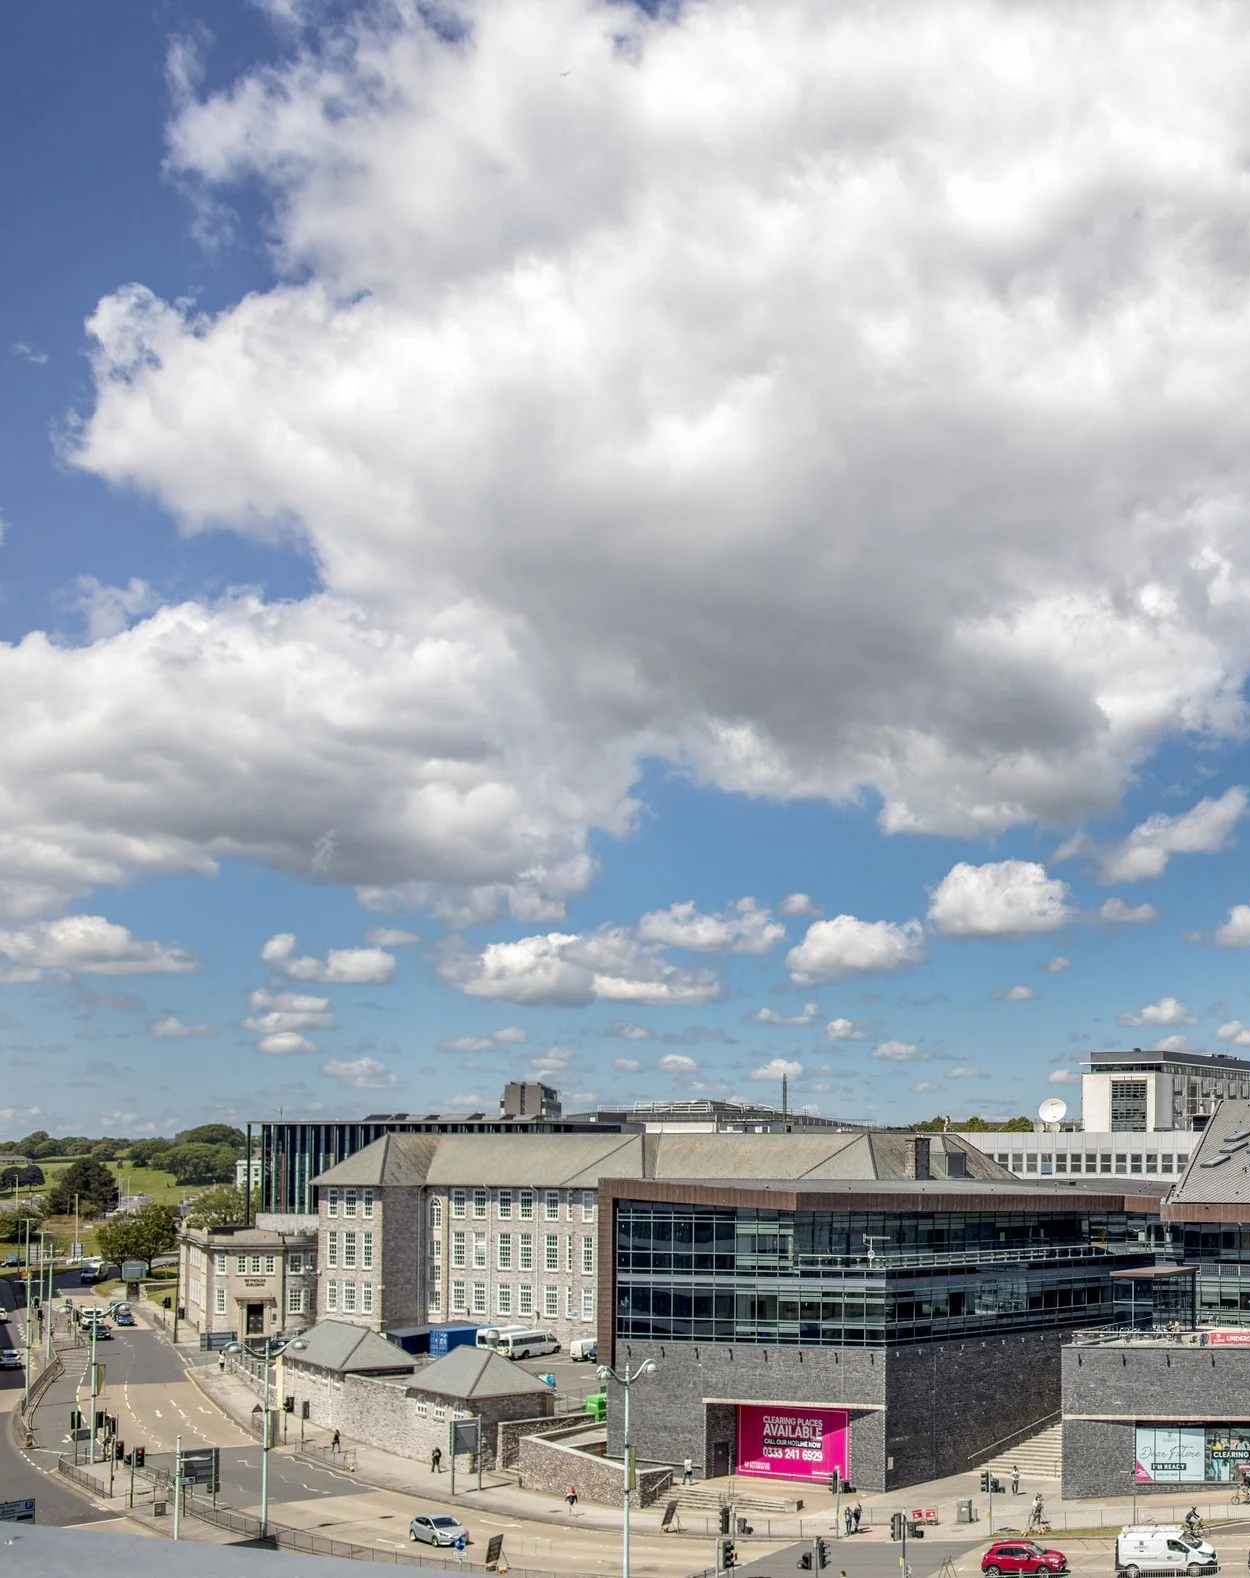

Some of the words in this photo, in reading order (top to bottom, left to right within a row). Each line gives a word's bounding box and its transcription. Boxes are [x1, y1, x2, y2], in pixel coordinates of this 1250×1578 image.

[763, 1415, 796, 1425] CLEARING
[797, 1419, 823, 1427] PLACES
[763, 1424, 823, 1439] AVAILABLE
[763, 1447, 782, 1458] 0333
[784, 1449, 800, 1459] 241
[802, 1450, 823, 1461] 6929
[1140, 1446, 1167, 1459] Dear
[1169, 1445, 1202, 1460] Future
